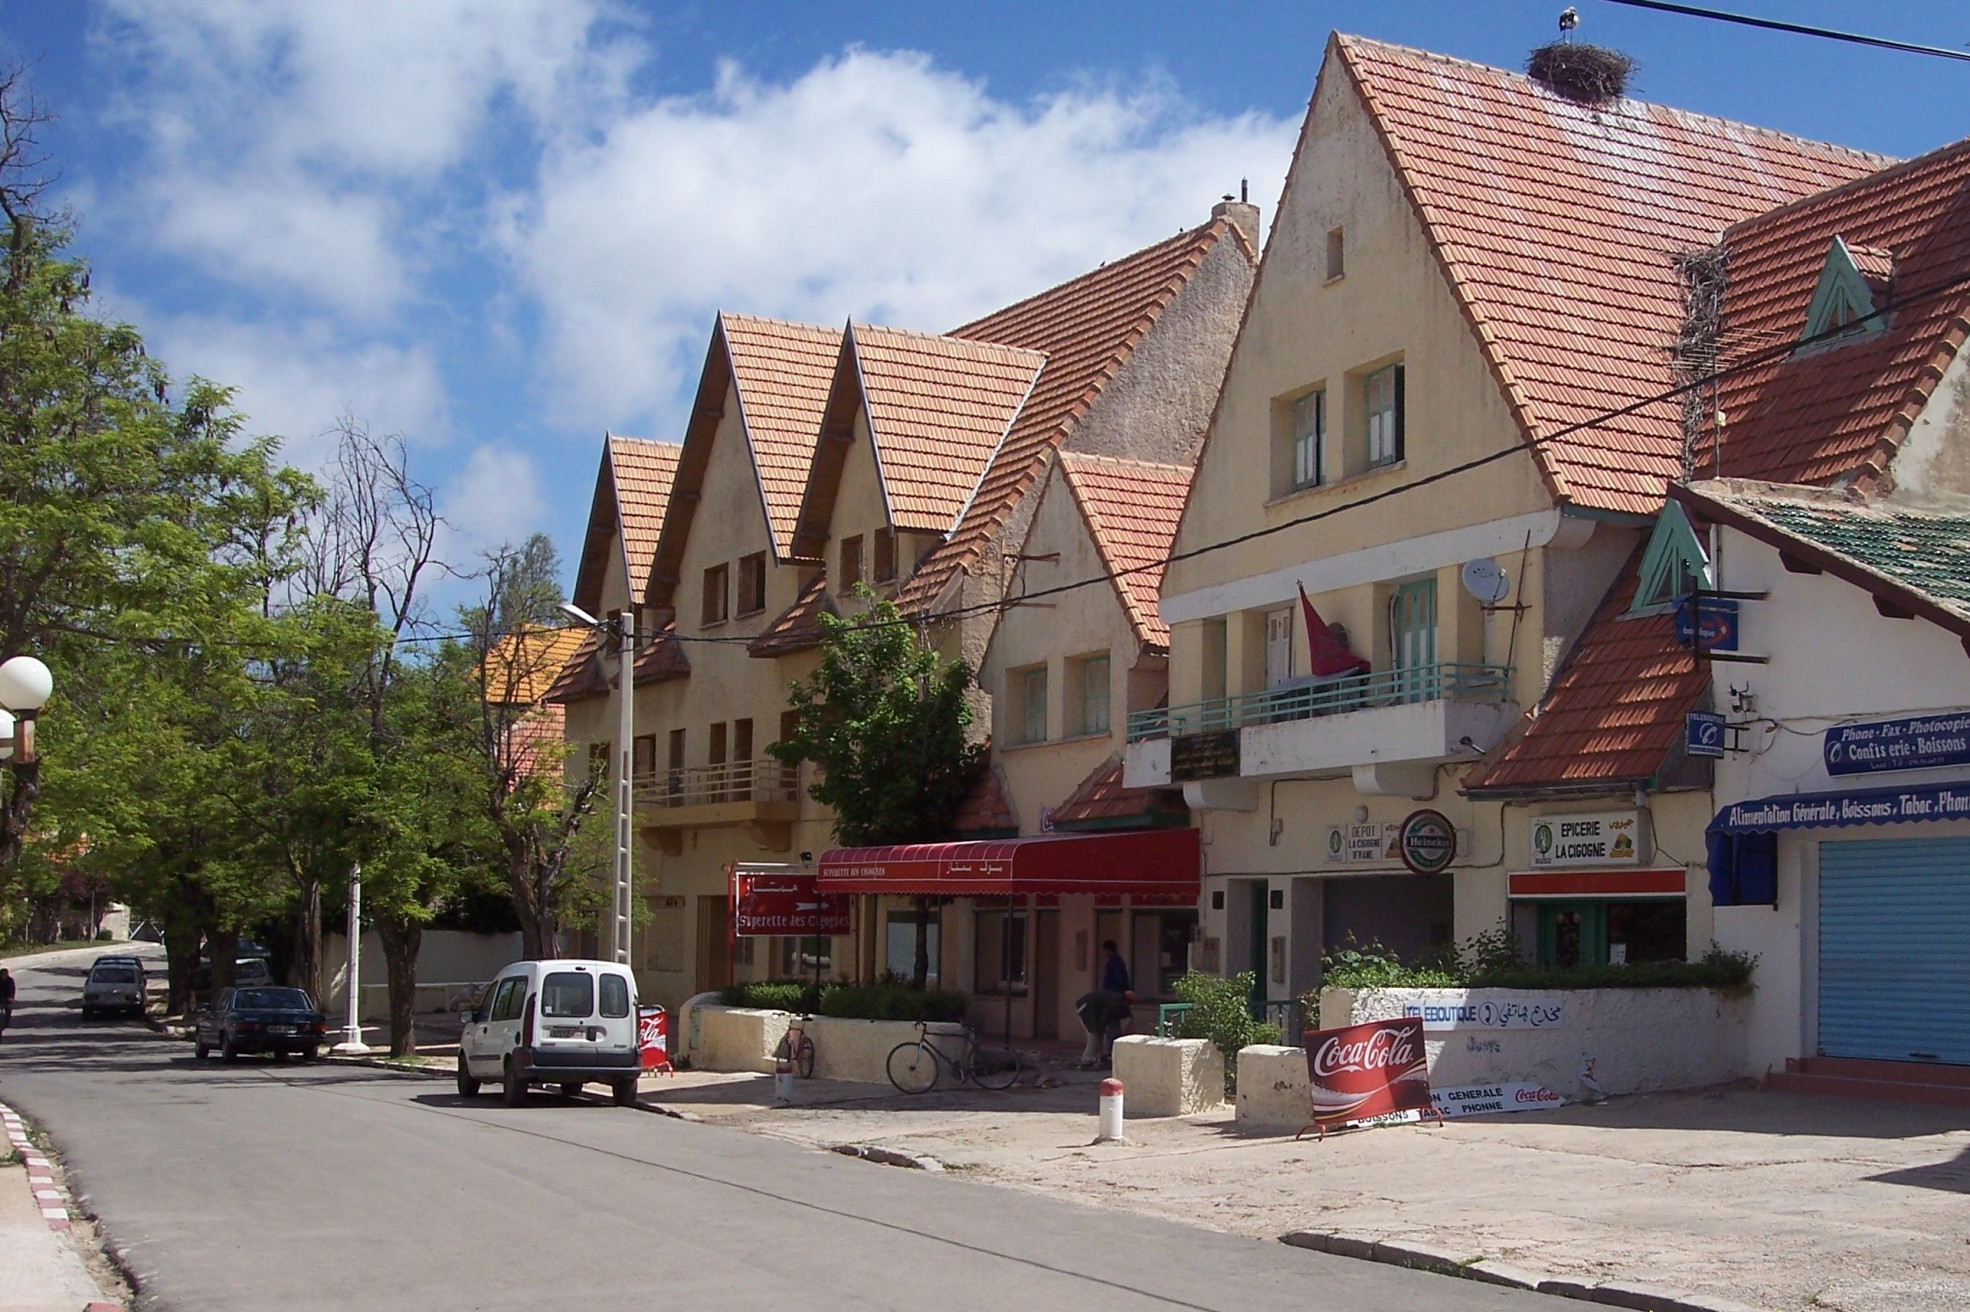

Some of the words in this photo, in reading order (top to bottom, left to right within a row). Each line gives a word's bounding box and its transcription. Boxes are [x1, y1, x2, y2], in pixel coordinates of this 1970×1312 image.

[1682, 625, 1716, 638] boique
[1841, 728, 1874, 742] Phone
[1881, 724, 1901, 738] Fax
[1917, 736, 1967, 755] Boissons
[1728, 806, 1791, 827] Alimentation
[1938, 790, 1970, 813] Phon
[1352, 825, 1375, 838] DEPOT
[1561, 820, 1600, 838] EPICERIE
[1348, 839, 1356, 848] LA
[1410, 836, 1450, 848] Heineken
[1555, 844, 1567, 859] LA
[1568, 842, 1606, 859] CIGOGNE
[823, 867, 849, 877] SUPERETTE
[850, 867, 859, 876] DES
[860, 866, 885, 877] CIGOGNES
[740, 914, 785, 929] Superette
[789, 914, 806, 927] des
[808, 914, 850, 929] Cgognes
[1499, 1002, 1527, 1027] هاتفي
[1529, 1006, 1562, 1027] مخدع
[1314, 1025, 1418, 1077] Coca-Cola
[1448, 1087, 1504, 1102] GENERALE
[1515, 1086, 1560, 1103] Coca-Cola
[1358, 1110, 1409, 1124] BOISSONS
[1461, 1100, 1504, 1113] PHONNE
